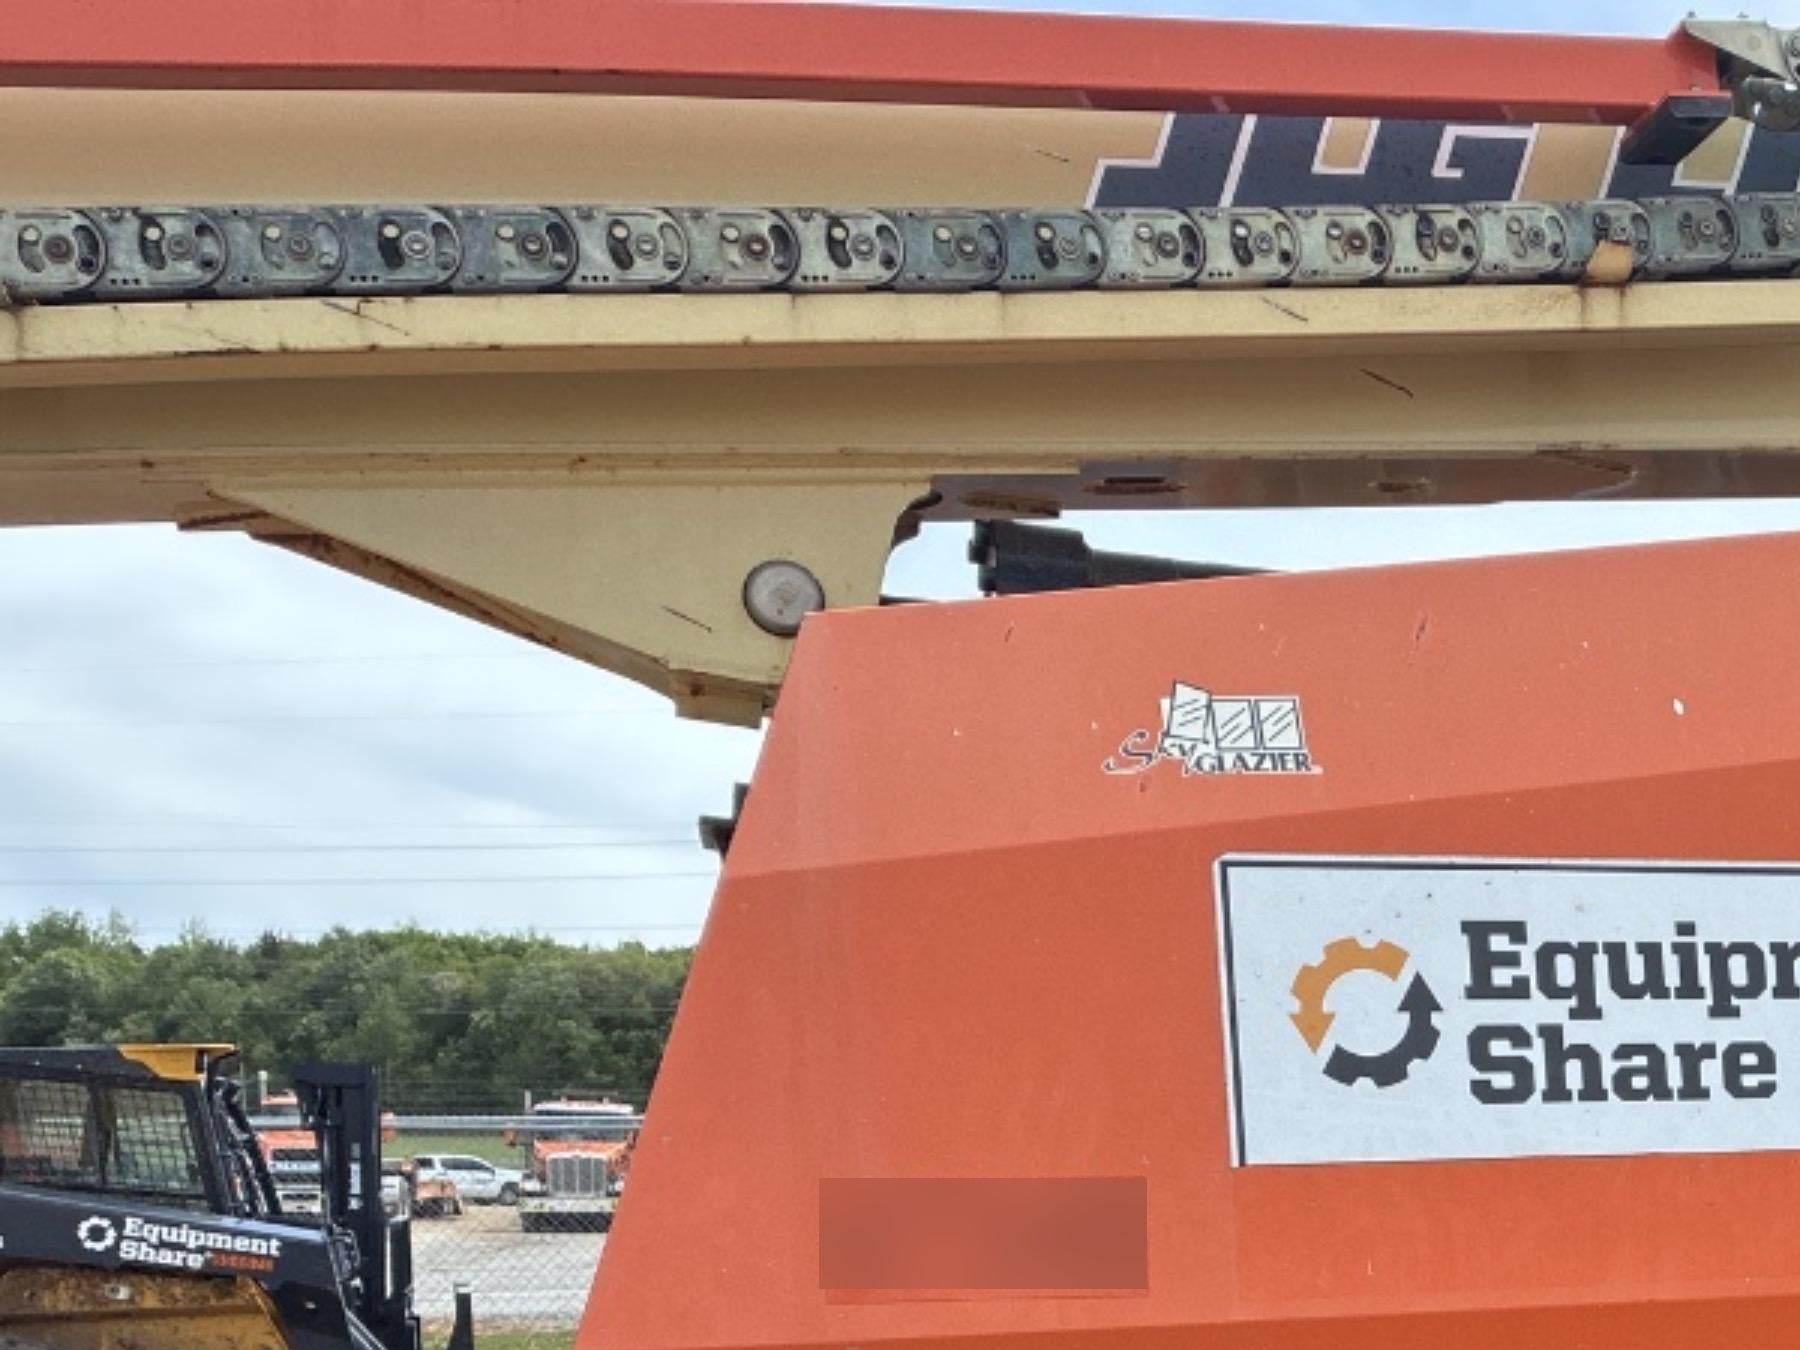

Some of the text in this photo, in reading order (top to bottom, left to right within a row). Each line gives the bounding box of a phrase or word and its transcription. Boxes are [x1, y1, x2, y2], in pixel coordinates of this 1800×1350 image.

[1466, 1023, 1778, 1104] Share
[118, 1238, 204, 1270] Share
[123, 1216, 282, 1257] Equipment
